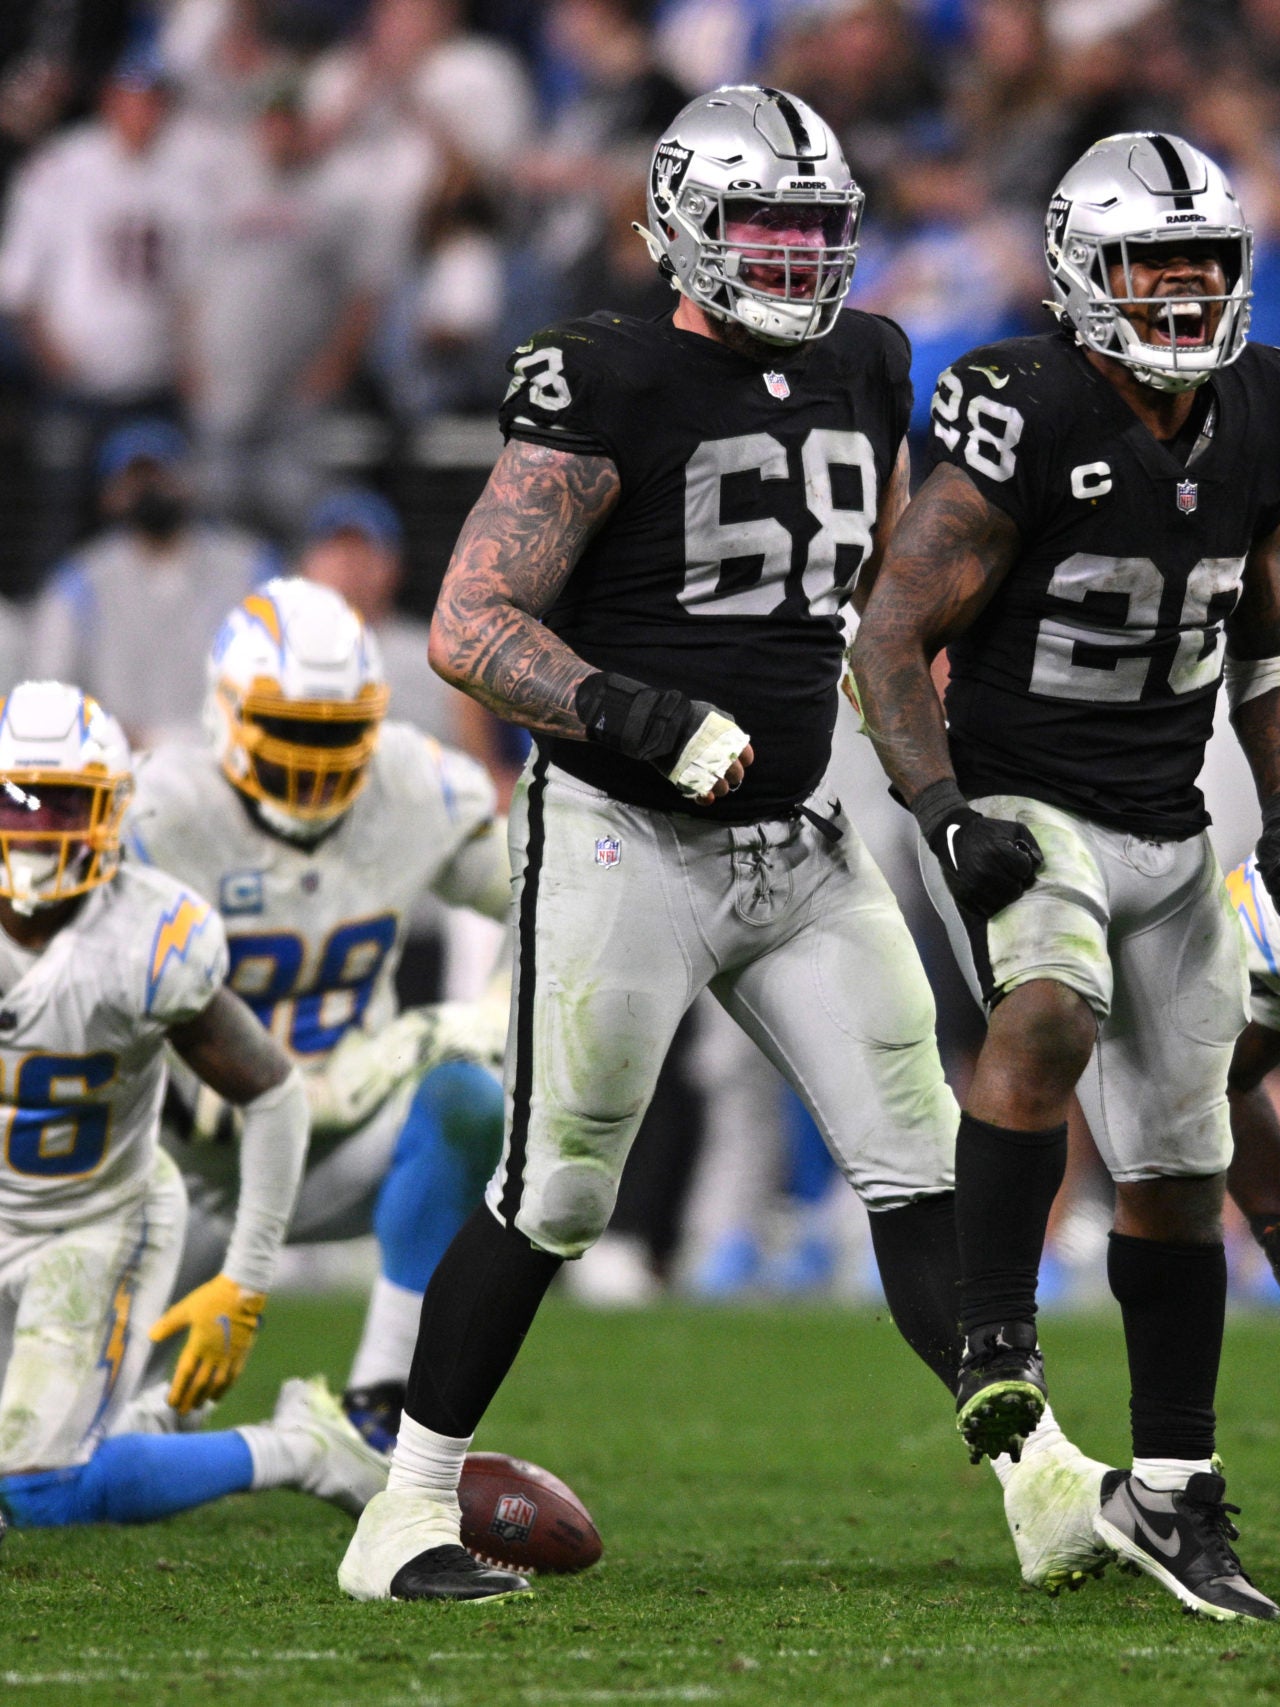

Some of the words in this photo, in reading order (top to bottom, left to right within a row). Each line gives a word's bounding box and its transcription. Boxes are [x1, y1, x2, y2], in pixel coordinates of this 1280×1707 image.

[790, 181, 827, 190] RAIDERS
[1165, 213, 1207, 224] RAIDERS
[931, 366, 1025, 483] 28
[1071, 461, 1112, 499] C
[676, 428, 877, 616] 68
[0, 1049, 119, 1179] 6
[502, 1499, 533, 1528] NFL
